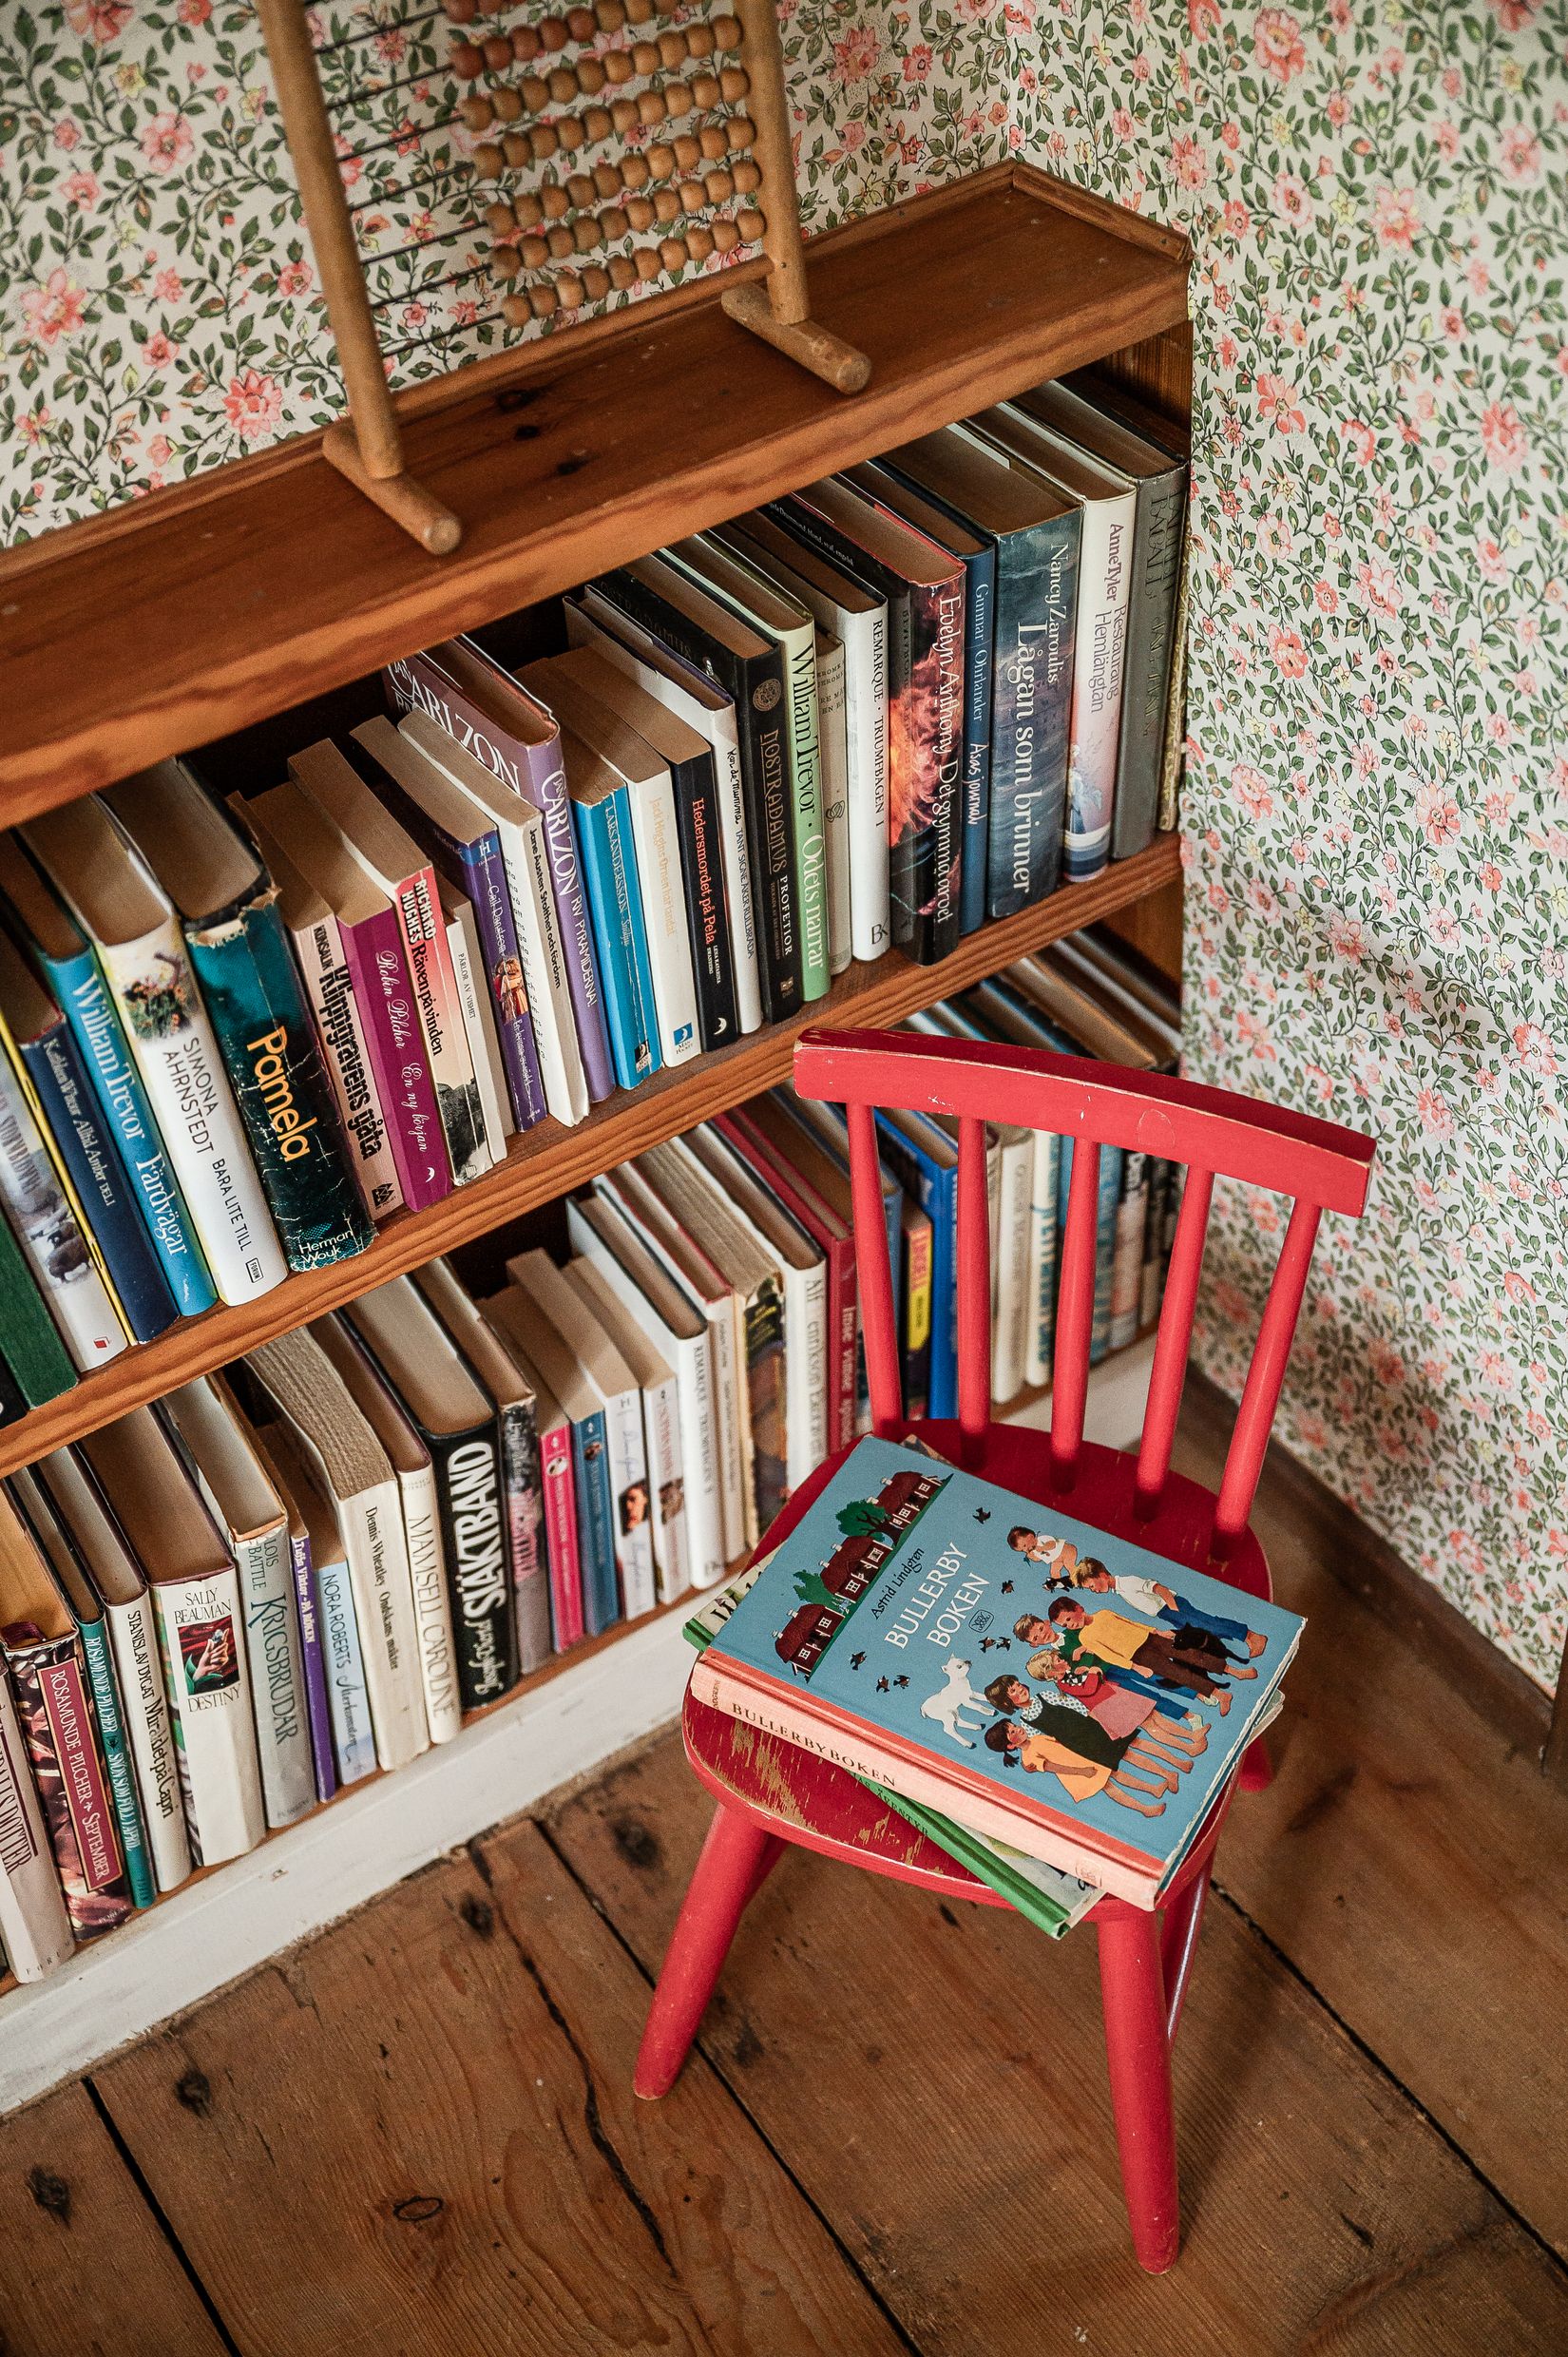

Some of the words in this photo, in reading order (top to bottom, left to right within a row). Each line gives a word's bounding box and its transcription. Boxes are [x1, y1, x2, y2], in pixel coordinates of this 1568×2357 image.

[1044, 543, 1070, 605] Nancy
[1108, 523, 1124, 565] Anne
[1104, 563, 1122, 602] Tyler
[933, 596, 963, 669] Evelyn
[973, 584, 990, 645] Gunnar
[1047, 603, 1070, 684] Zaroulis
[872, 621, 884, 703] REMARQUE
[1007, 622, 1048, 720] Lågan
[1088, 609, 1112, 714] Hemlängtan
[1106, 604, 1128, 700] Restaurang
[792, 642, 816, 742] William
[932, 669, 961, 755] Anthony
[972, 648, 989, 721] Ohrlander
[795, 737, 818, 814] Trevor
[939, 758, 959, 799] Det
[1014, 727, 1035, 787] som
[650, 797, 661, 819] Jack
[962, 776, 988, 826] journal
[542, 770, 579, 896] CARLZON
[654, 819, 666, 858] Higgins
[692, 797, 714, 895] Hedersmordet
[736, 830, 745, 853] TANT
[931, 799, 954, 875] grymma
[1012, 790, 1042, 894] brinner
[611, 834, 628, 914] ANDERSSON
[738, 854, 747, 883] SIGNE
[400, 890, 422, 944] HUGHES
[413, 878, 437, 939] RICHARD
[534, 853, 545, 892] Austen
[541, 891, 553, 931] Stolthet
[550, 950, 561, 989] fördom
[571, 894, 583, 916] RIV
[699, 896, 716, 915] på
[703, 915, 717, 945] Pela
[780, 875, 793, 955] PROFETIOR
[935, 876, 954, 924] arvet
[314, 925, 335, 970] KONSALIK
[411, 942, 430, 990] Räven
[575, 919, 597, 1007] PYRAMIDERNA!
[806, 904, 823, 969] narrar
[375, 949, 398, 997] Robin
[417, 988, 434, 1008] på
[464, 982, 471, 993] AV
[387, 999, 411, 1048] Pilcher
[425, 1006, 443, 1056] vinden
[466, 991, 476, 1019] VISHET
[319, 965, 370, 1112] Klippgravens
[182, 1037, 220, 1117] SIMONA
[247, 1025, 317, 1161] Pamela
[401, 1063, 423, 1088] En
[401, 1092, 418, 1110] ny
[72, 974, 118, 1074] William
[105, 1062, 145, 1140] Trevor
[136, 1151, 187, 1255] Färdvägar
[348, 1110, 383, 1160] gåta
[407, 1114, 430, 1152] början
[73, 1119, 98, 1153] Alltid
[86, 1149, 106, 1183] Amber
[163, 1051, 215, 1154] AHRNSTEDT
[212, 1158, 234, 1197] BARA
[223, 1195, 244, 1225] LITE
[235, 1220, 252, 1252] TILL
[249, 1261, 261, 1280] FORUM
[298, 1231, 354, 1255] Herman
[301, 1247, 342, 1263] Wouk
[263, 1539, 279, 1568] LOIS
[365, 1506, 381, 1543] Dennis
[447, 1442, 507, 1618] SLÄKTBAND
[248, 1545, 267, 1591] BATTLE
[373, 1541, 387, 1587] Wheatley
[409, 1514, 442, 1621] MAMSELL
[870, 1581, 896, 1619] Astrid
[891, 1547, 925, 1588] Lindgren
[174, 1600, 233, 1624] BEAUMAN
[185, 1587, 218, 1606] SALLY
[322, 1573, 339, 1613] NORA
[333, 1613, 352, 1670] ROBERTS
[378, 1591, 395, 1638] Ondskans
[884, 1542, 968, 1650] BULLERBY
[927, 1571, 992, 1649] BOKEN
[85, 1638, 110, 1696] ROSAMUNDE
[248, 1595, 298, 1746] KRIGSBRUDAR
[423, 1623, 454, 1718] CAROLINE
[97, 1694, 119, 1734] PILCHER
[127, 1610, 149, 1668] STANISLAV
[138, 1665, 155, 1699] DYGAT
[156, 1776, 179, 1819] Capri
[188, 1686, 240, 1713] DESTINY
[732, 1701, 896, 1788] BULLERBYBOKEN
[50, 1670, 82, 1752] ROSAMUNDE
[68, 1751, 93, 1805] PILCHER
[82, 1812, 110, 1881] SEPTEMBER
